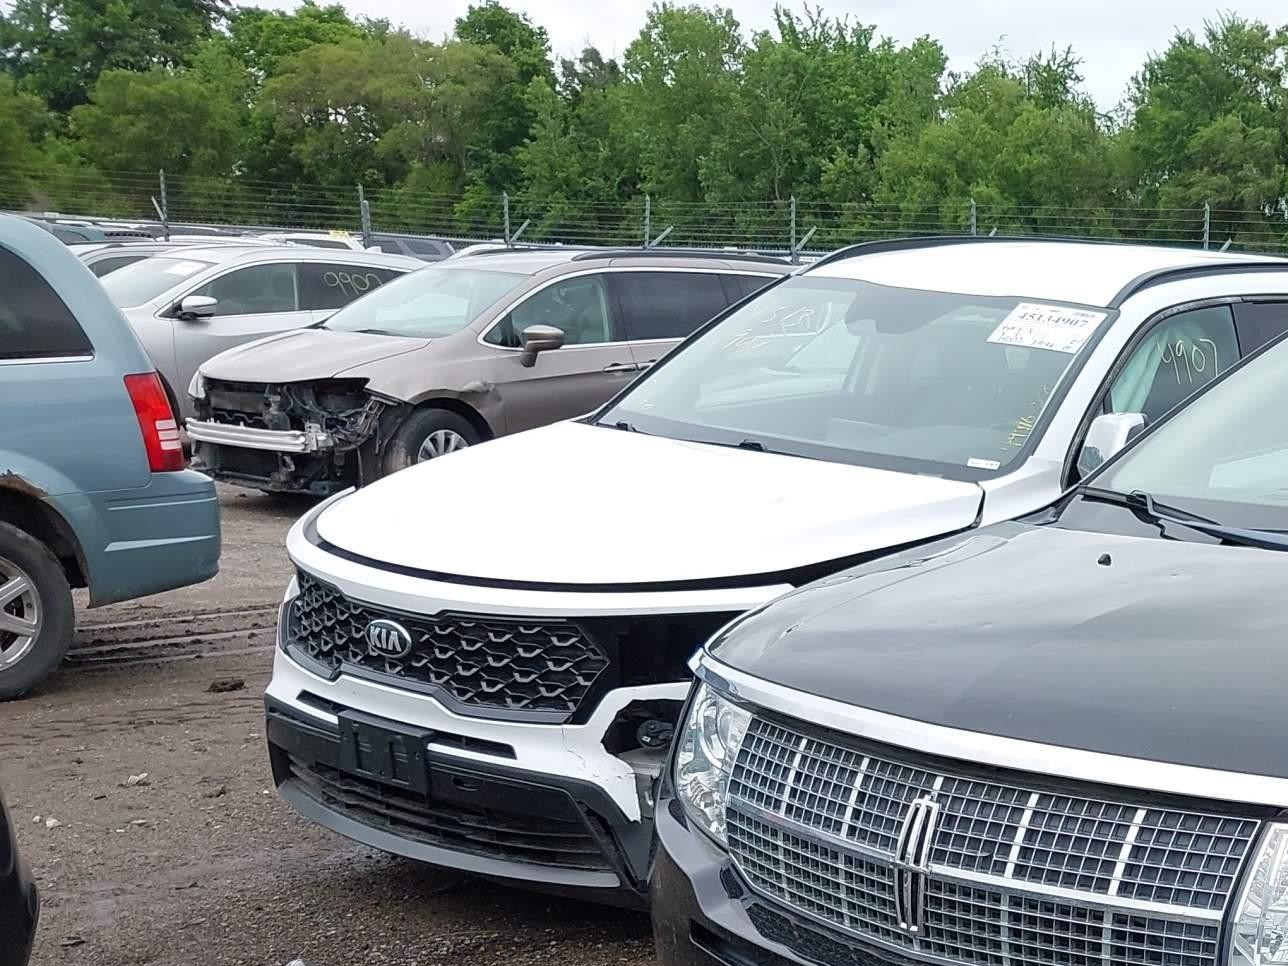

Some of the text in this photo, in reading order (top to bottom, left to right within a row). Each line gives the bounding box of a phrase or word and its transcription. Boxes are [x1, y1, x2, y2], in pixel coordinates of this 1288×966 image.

[1018, 312, 1089, 328] 45134907
[1156, 338, 1219, 385] 4907
[369, 625, 403, 653] KIA
